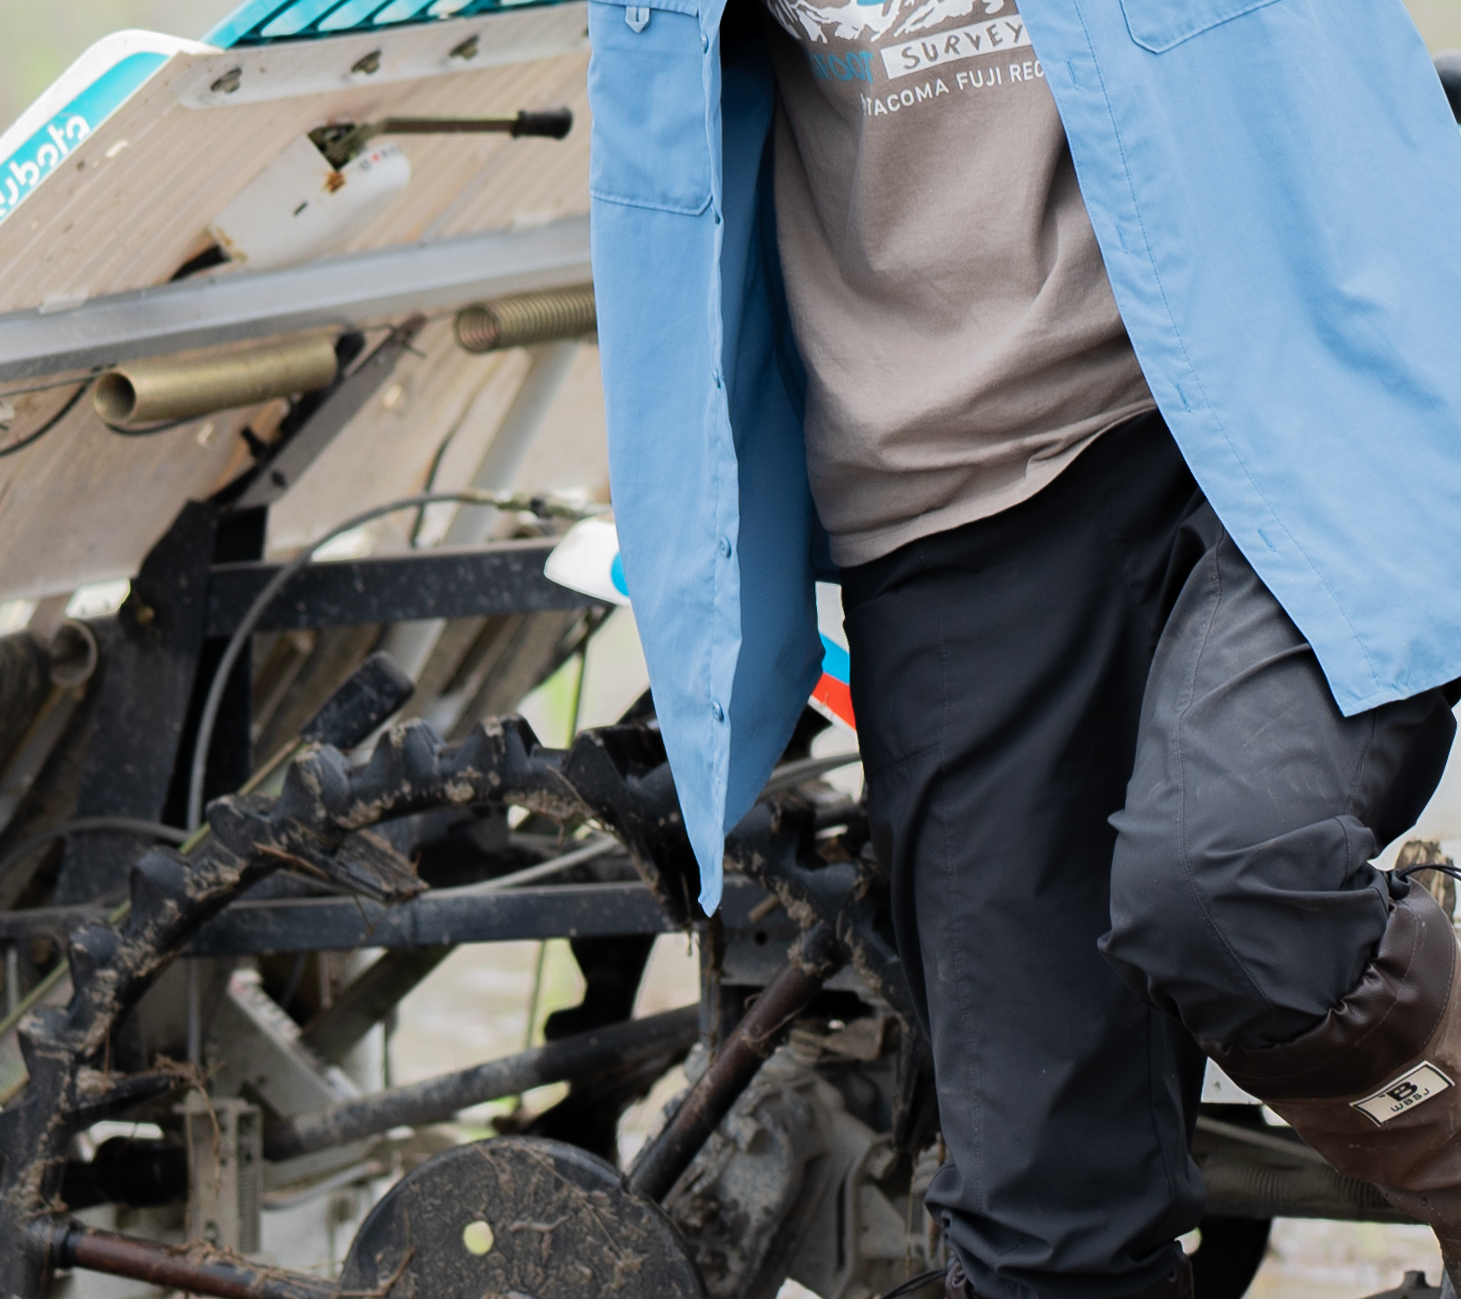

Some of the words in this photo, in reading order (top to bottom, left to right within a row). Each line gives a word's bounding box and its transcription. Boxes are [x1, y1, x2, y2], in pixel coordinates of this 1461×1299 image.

[900, 21, 1024, 70] SURVEY
[956, 67, 1002, 91] FUJI
[1385, 1081, 1418, 1102] B
[1390, 1087, 1430, 1113] WBSJ
